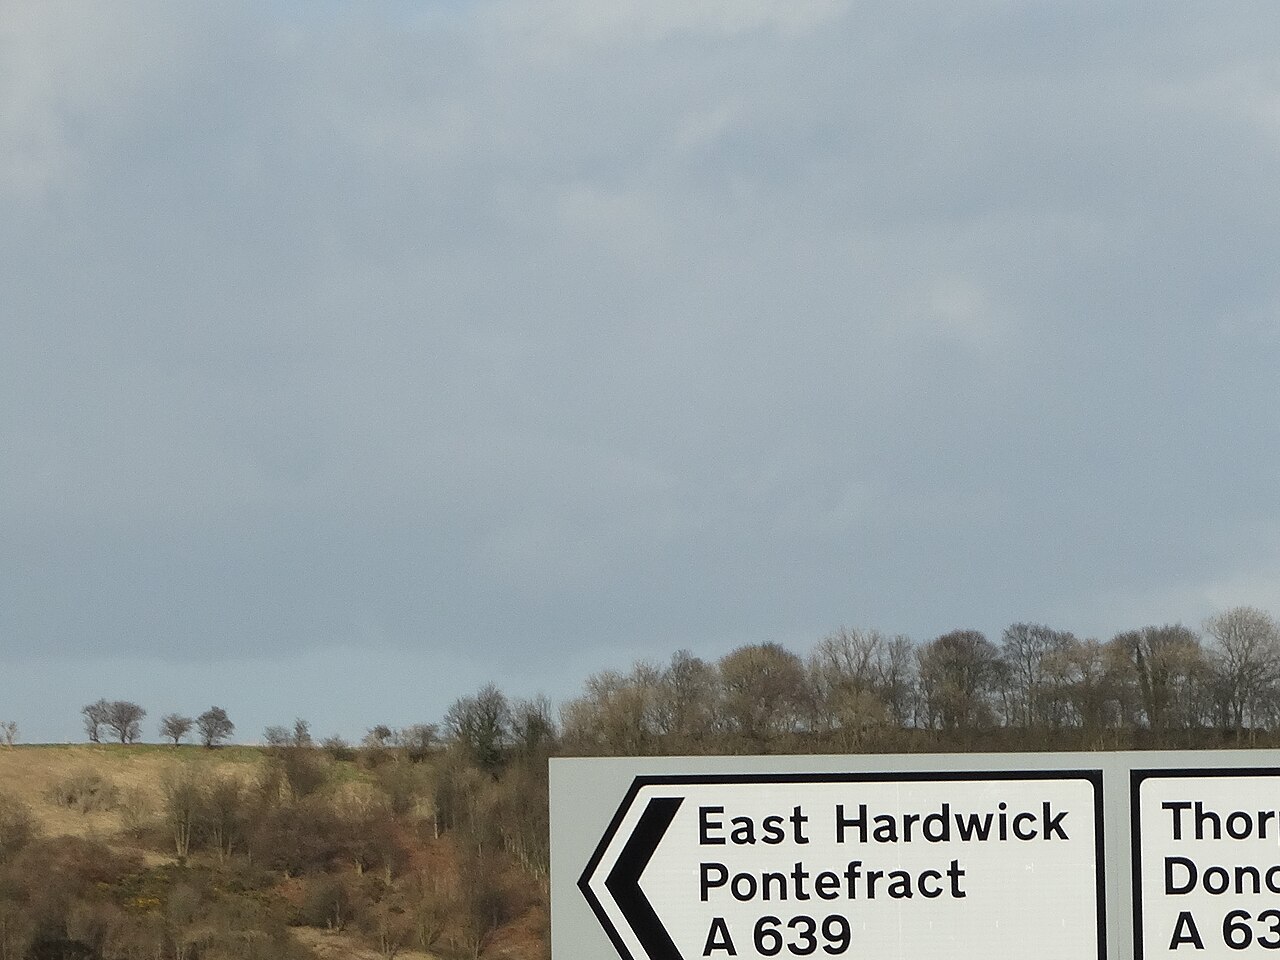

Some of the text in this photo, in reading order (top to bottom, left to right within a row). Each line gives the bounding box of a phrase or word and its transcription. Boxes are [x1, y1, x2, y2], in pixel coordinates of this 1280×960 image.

[698, 801, 1070, 846] East Hardwick
[699, 859, 967, 902] Pontefract
[702, 914, 852, 957] A 639
[1168, 911, 1205, 951] A
